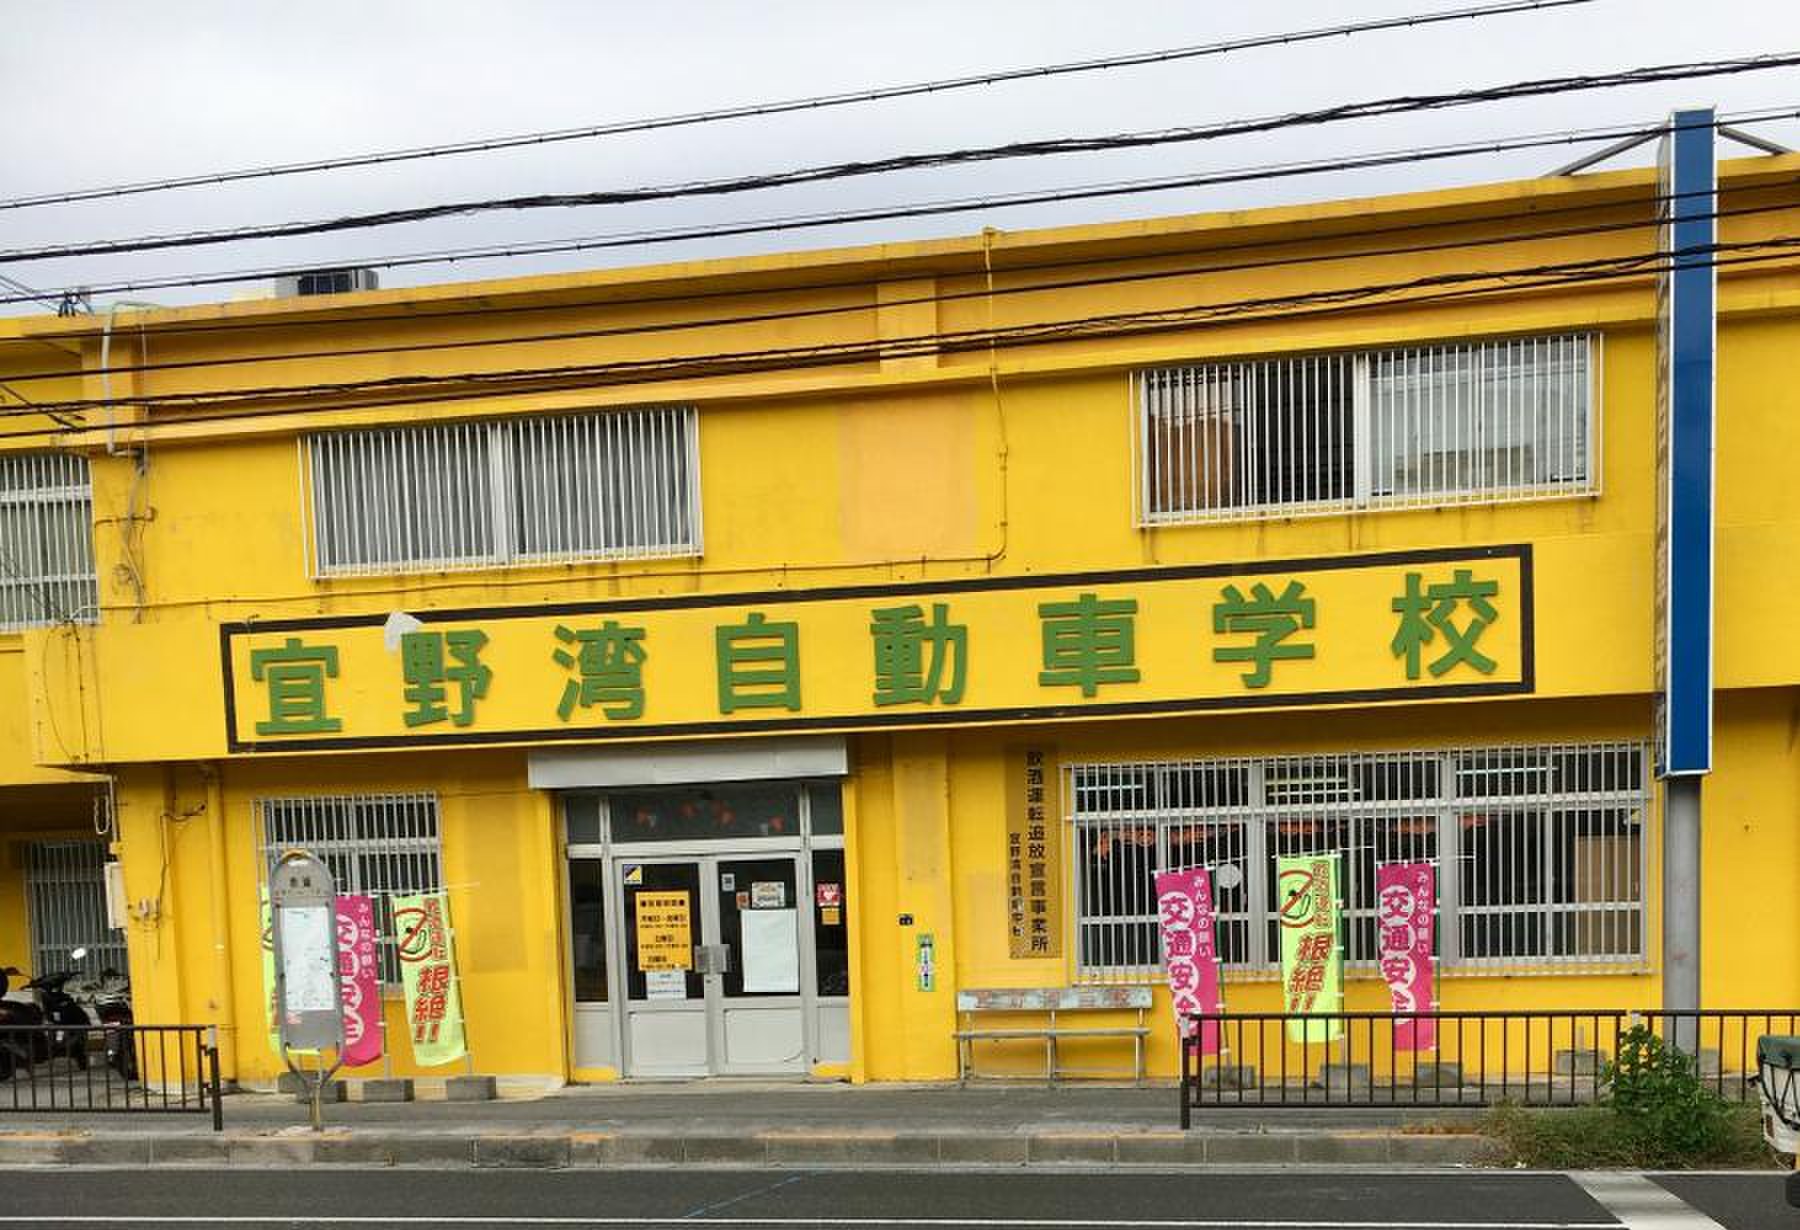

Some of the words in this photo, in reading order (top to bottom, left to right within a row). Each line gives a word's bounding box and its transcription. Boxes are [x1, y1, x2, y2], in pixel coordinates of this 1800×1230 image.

[250, 569, 1500, 736] 宜野湾自動車学校
